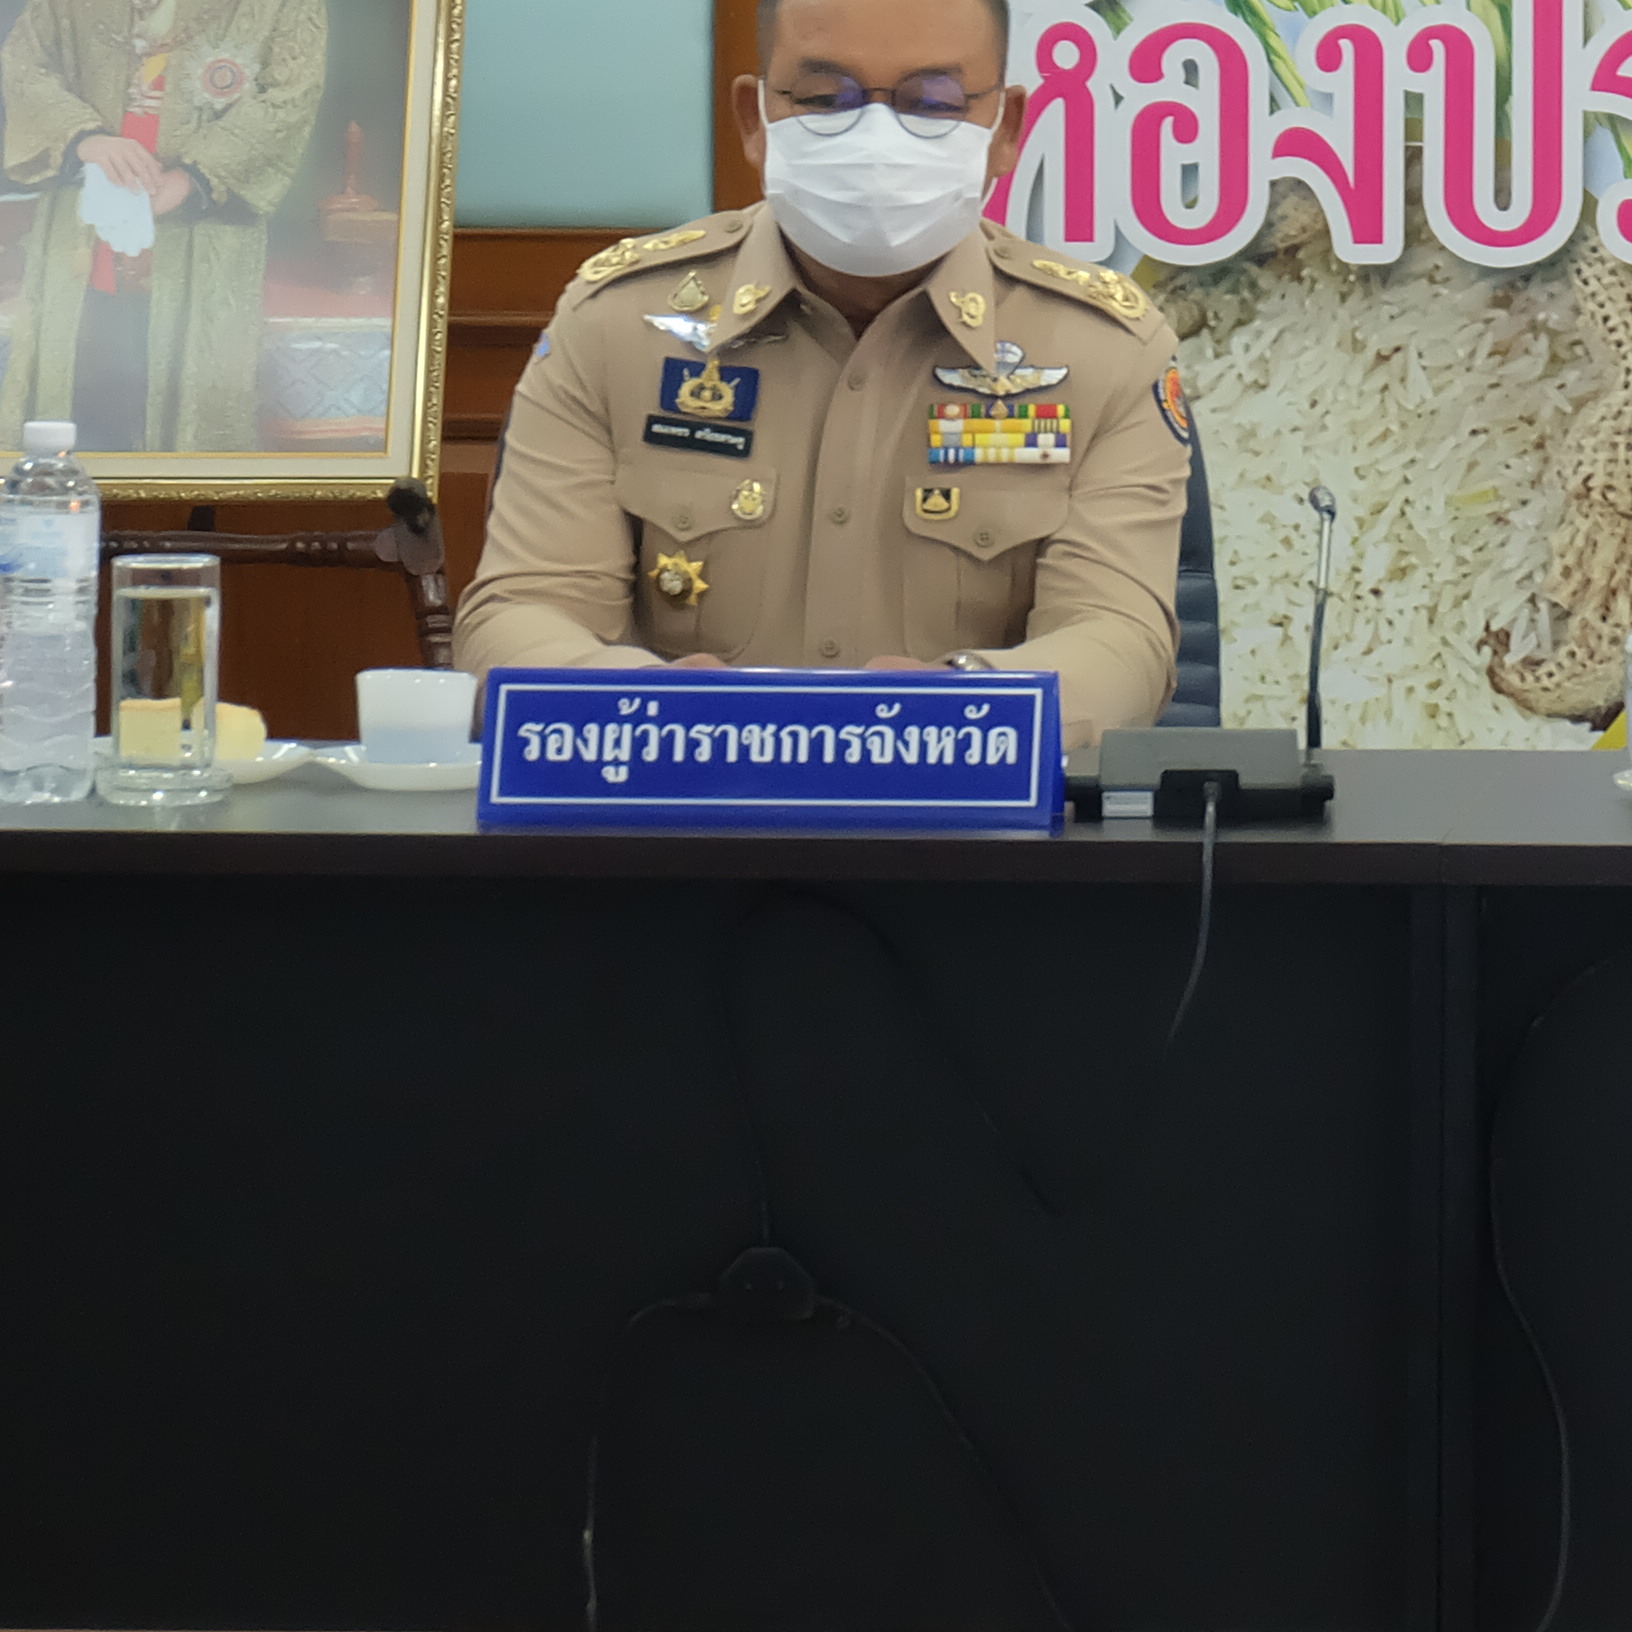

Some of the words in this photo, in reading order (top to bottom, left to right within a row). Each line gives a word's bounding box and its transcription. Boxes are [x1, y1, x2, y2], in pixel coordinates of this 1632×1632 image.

[517, 697, 1018, 784] รองผู้ว่าราชการจังหวัด
